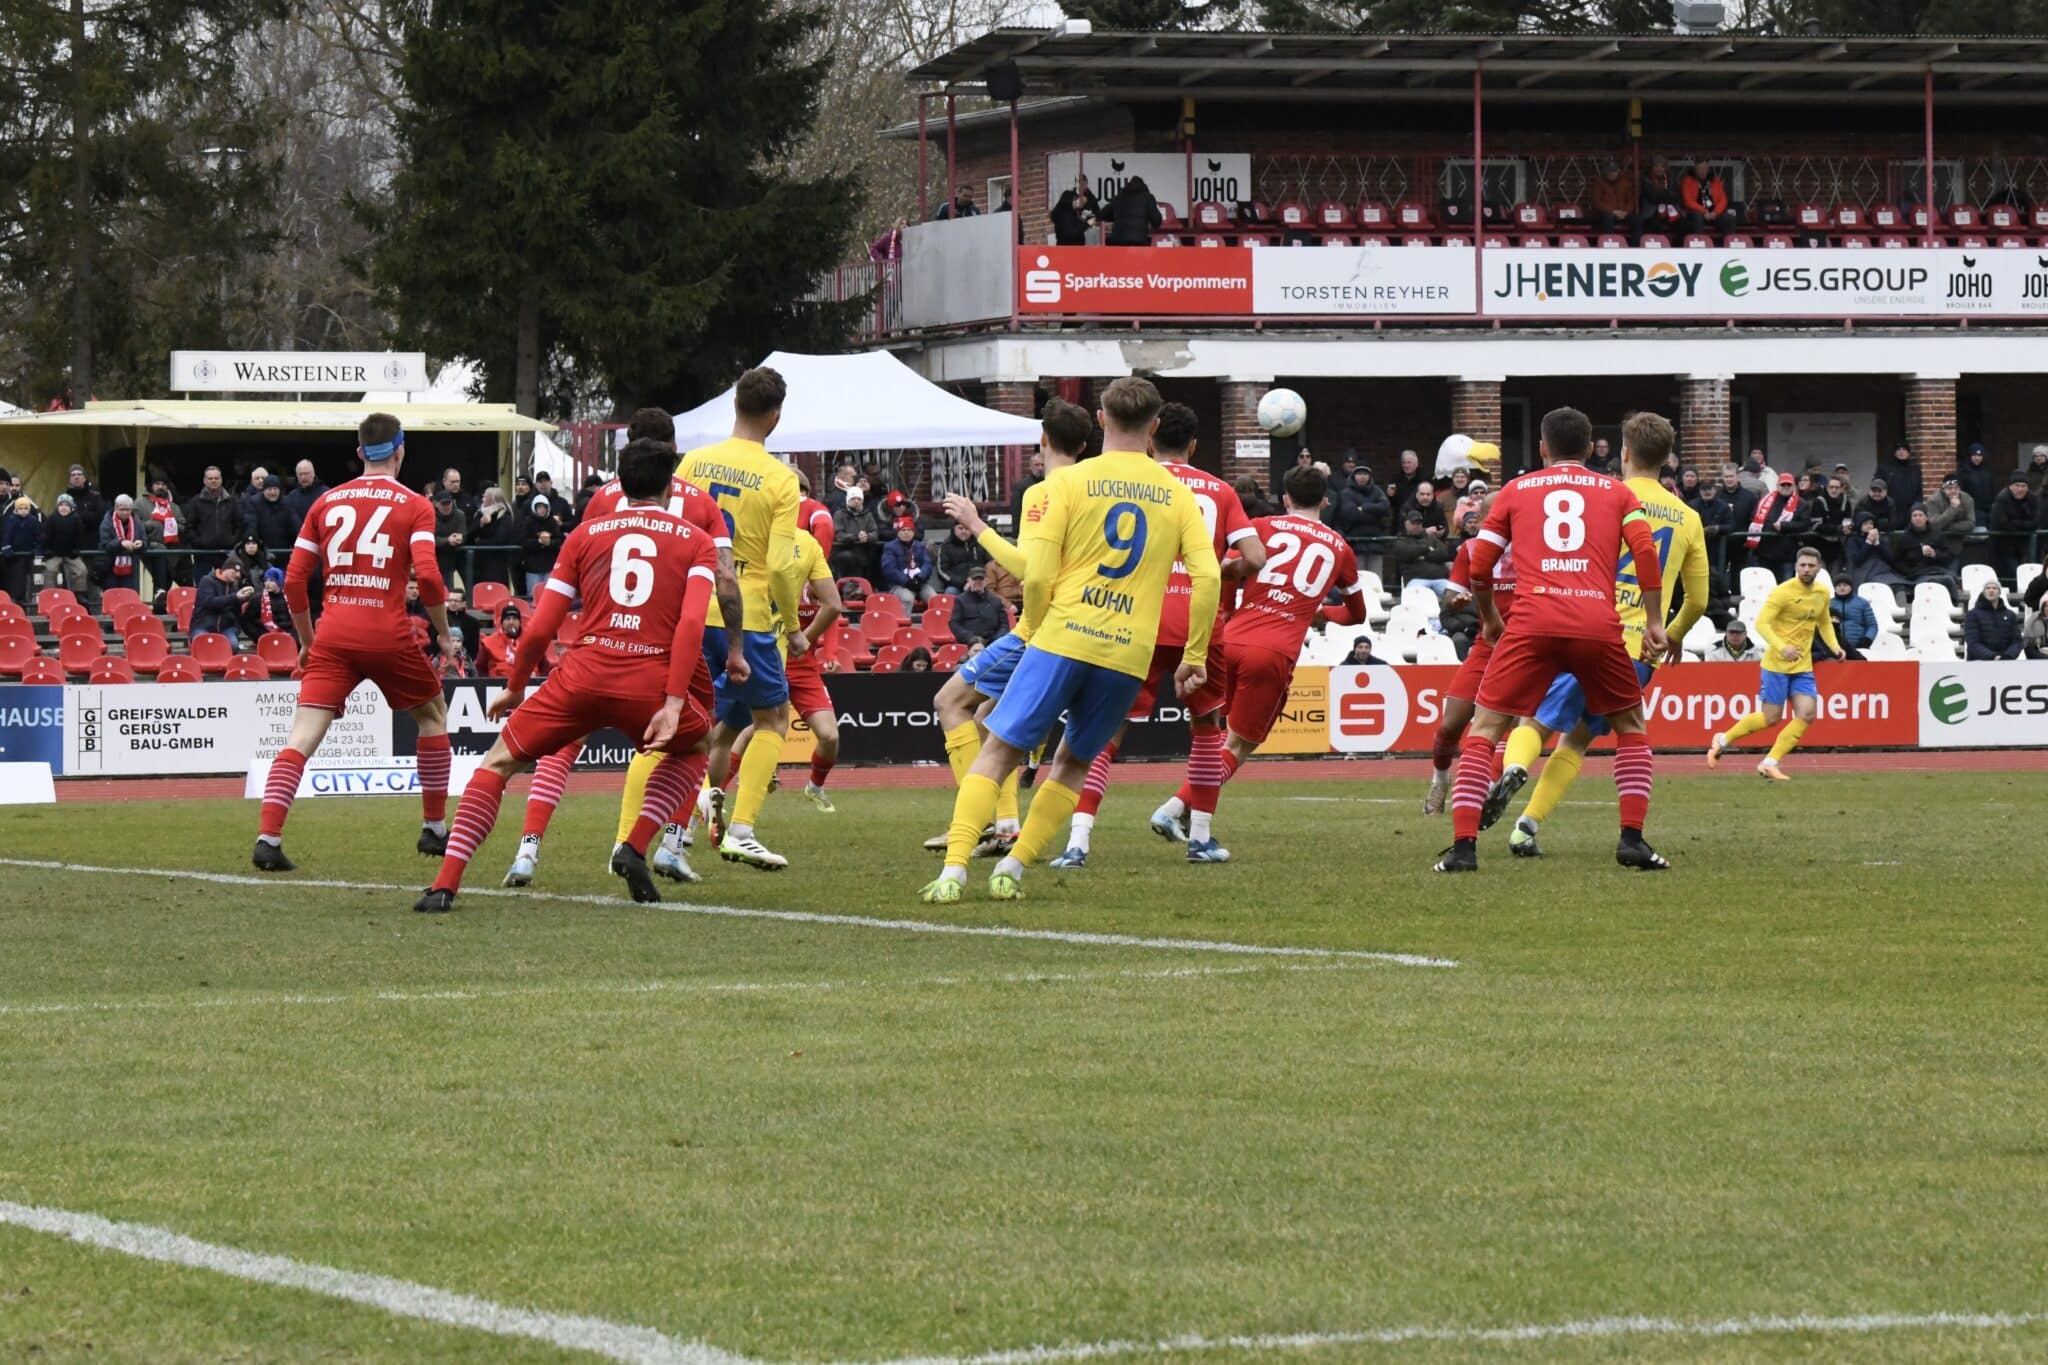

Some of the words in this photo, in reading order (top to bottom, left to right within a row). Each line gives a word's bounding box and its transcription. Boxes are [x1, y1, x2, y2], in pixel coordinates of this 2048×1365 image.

[1096, 177, 1128, 202] JOH
[1192, 177, 1238, 203] JOHO
[1064, 272, 1143, 291] Sparkasse
[1146, 273, 1247, 291] Vorpommern
[1756, 267, 1928, 291] JES.GROUP
[1946, 273, 1992, 298] JOHO
[1280, 286, 1367, 299] TORSTEN
[1374, 286, 1449, 299] REYHER
[233, 362, 368, 382] WARSTEINER
[693, 461, 764, 491] LUCKENWALDE
[1516, 474, 1595, 490] GREIFSWALDER
[1598, 478, 1612, 490] FC
[325, 487, 393, 503] GREIFSWALDER
[393, 491, 408, 504] FC
[1087, 479, 1173, 506] LUCKENWALDE
[1207, 480, 1220, 492] FC
[588, 516, 673, 536] GREIFSWALDER
[675, 524, 692, 539] FC
[1542, 489, 1586, 552] 8
[324, 504, 395, 569] 24
[1096, 501, 1148, 579] 9
[1270, 518, 1334, 546] GREIFSWALDER
[1334, 537, 1345, 552] FC
[608, 533, 658, 608] 6
[1256, 532, 1336, 599] 20
[1541, 559, 1589, 572] BRANDT
[338, 596, 358, 605] SOLAR
[1081, 584, 1134, 615] KÜHN
[1267, 588, 1294, 605] VOGT
[1548, 587, 1573, 597] SOLAR
[609, 613, 641, 631] FARR
[1065, 621, 1114, 641] Märkischer
[1114, 633, 1132, 646] Hof
[598, 637, 626, 651] SOLAR
[255, 693, 274, 704] AM
[365, 691, 378, 702] 10
[108, 707, 228, 721] GREIFSWALDER
[259, 706, 293, 717] 17489
[119, 721, 182, 735] GERÜST
[130, 738, 214, 750] BAU-GMBH
[341, 735, 353, 744] 23
[356, 735, 375, 744] 423
